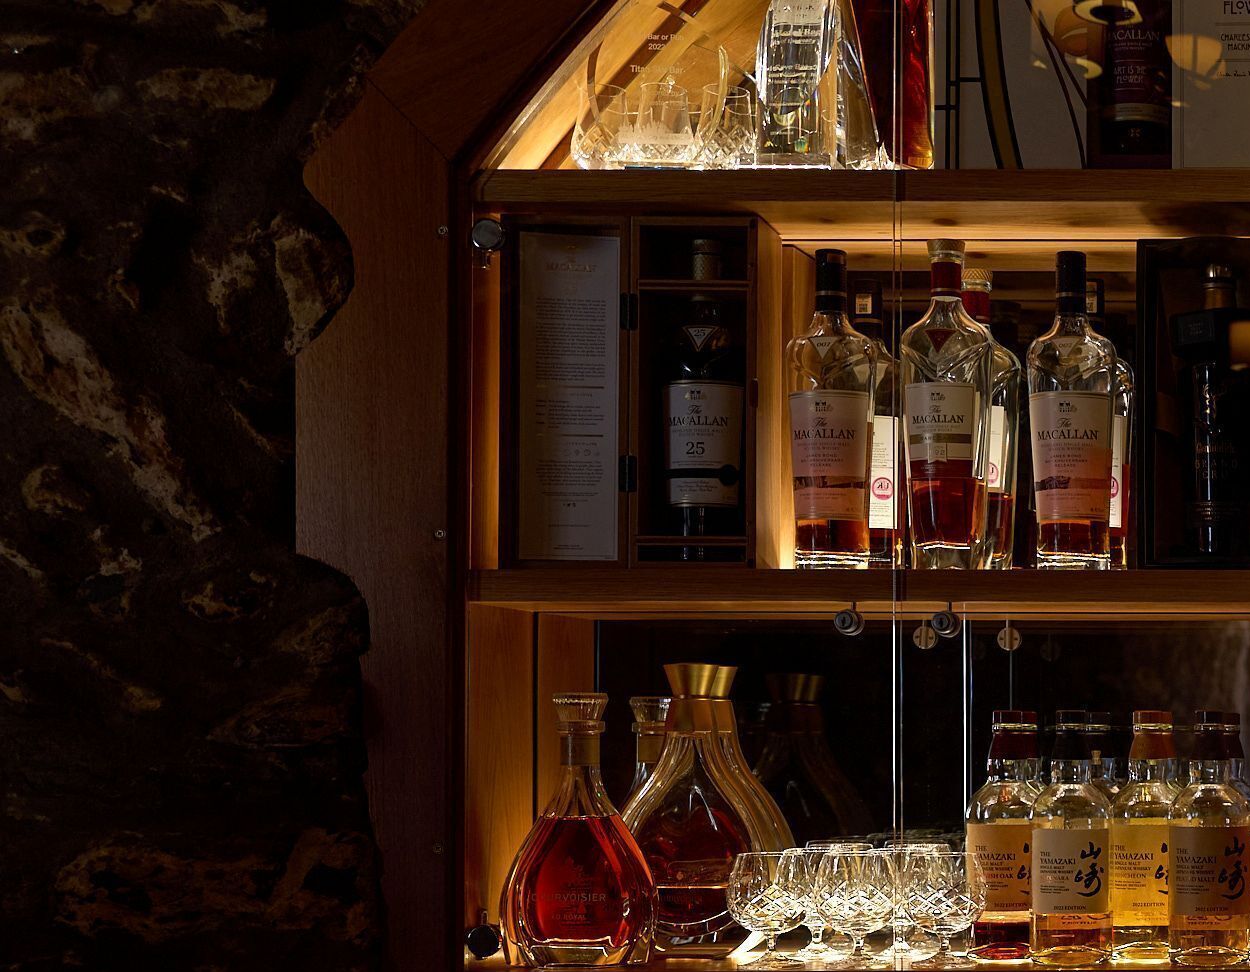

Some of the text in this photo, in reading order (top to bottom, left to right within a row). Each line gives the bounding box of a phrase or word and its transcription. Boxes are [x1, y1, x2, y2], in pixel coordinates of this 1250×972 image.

[1220, 34, 1250, 42] CHARLES
[693, 329, 706, 337] 25
[686, 404, 702, 415] The
[928, 405, 942, 414] The
[668, 416, 728, 426] MACALLAN
[812, 417, 828, 428] The
[912, 415, 965, 424] MACALLAN
[1057, 418, 1072, 428] The
[793, 429, 856, 440] MACALLAN
[1037, 429, 1099, 441] MACALLAN
[686, 441, 705, 455] 25
[1074, 841, 1104, 897] 山崎
[1218, 836, 1248, 900] 山崎
[531, 893, 606, 901] CRVOISIER
